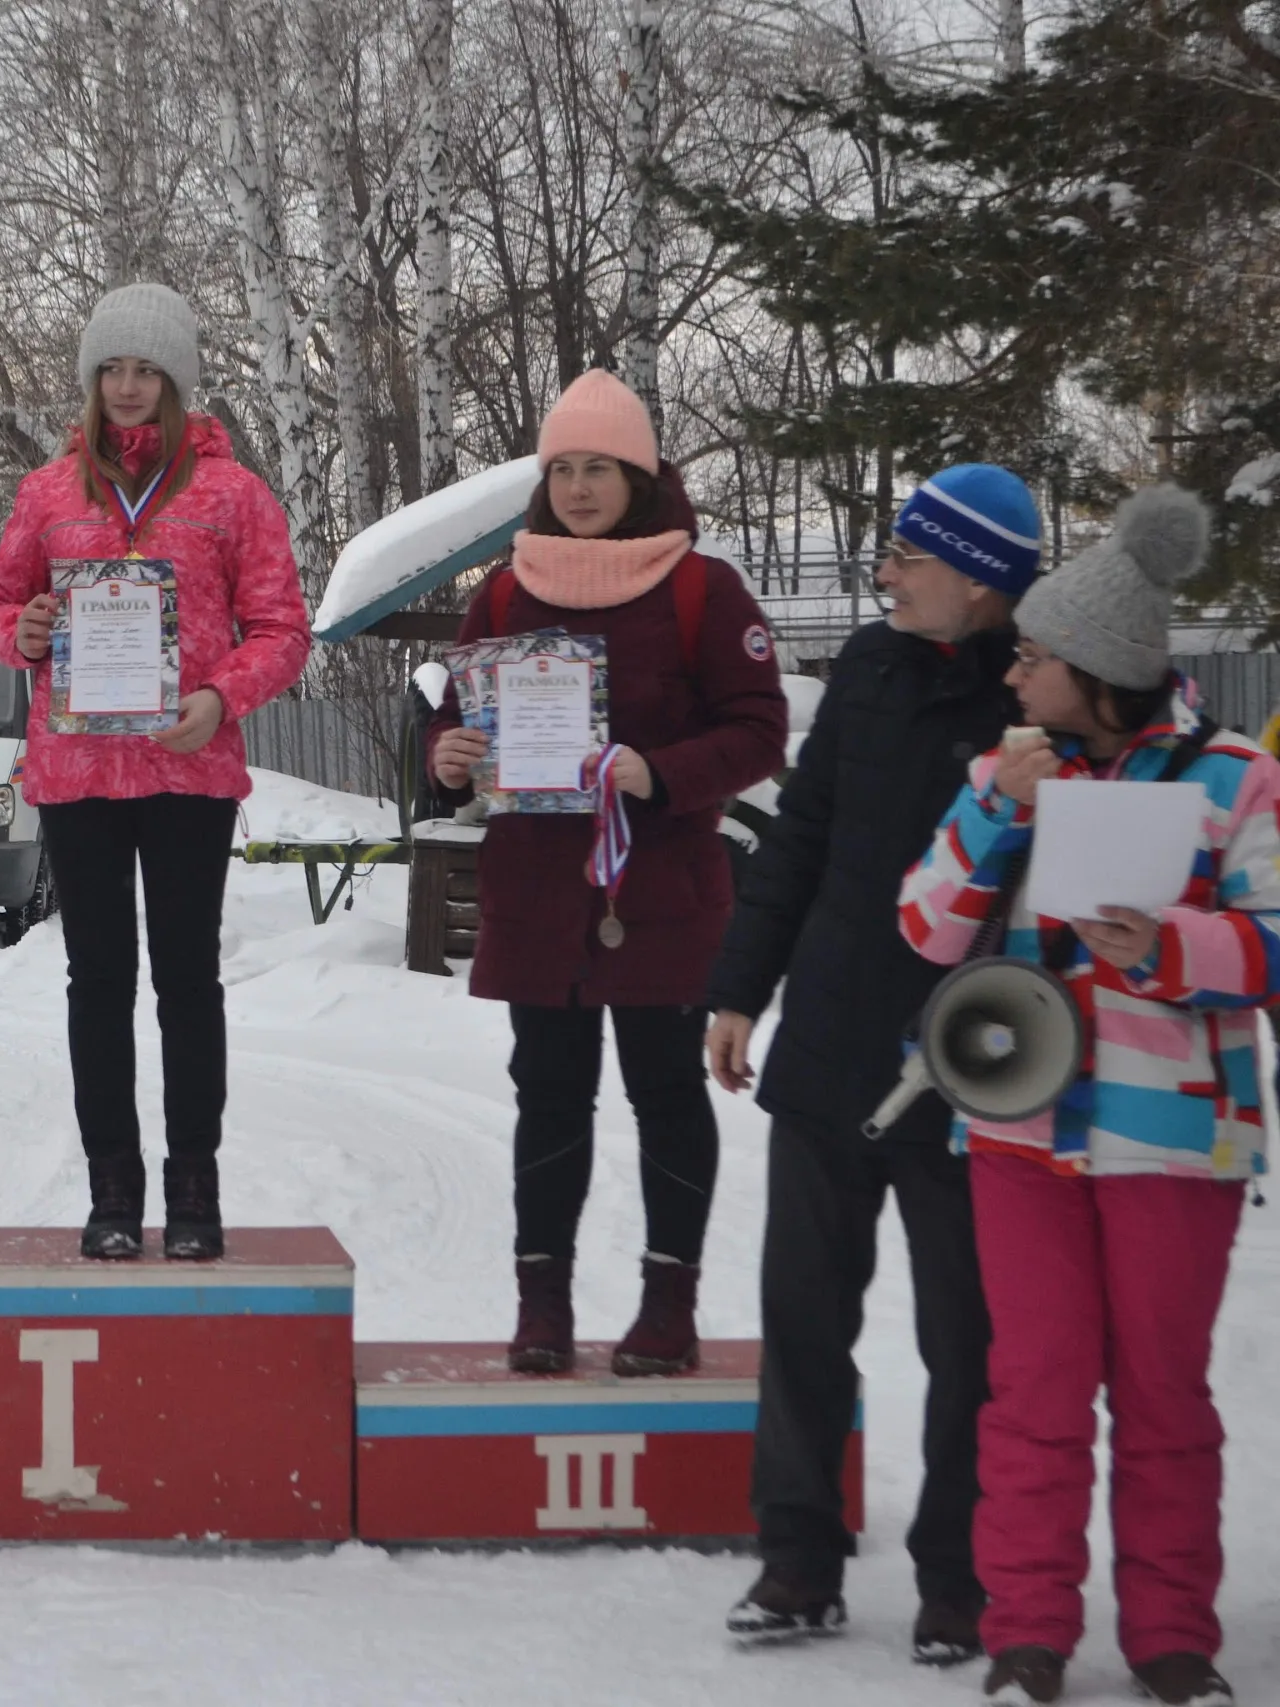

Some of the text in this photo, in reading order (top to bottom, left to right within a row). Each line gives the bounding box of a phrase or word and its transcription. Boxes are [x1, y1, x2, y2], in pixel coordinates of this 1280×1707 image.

[907, 511, 1012, 573] РОССИИ
[80, 599, 151, 613] ГРАМОТА
[19, 1328, 100, 1501] I
[534, 1432, 648, 1530] III
